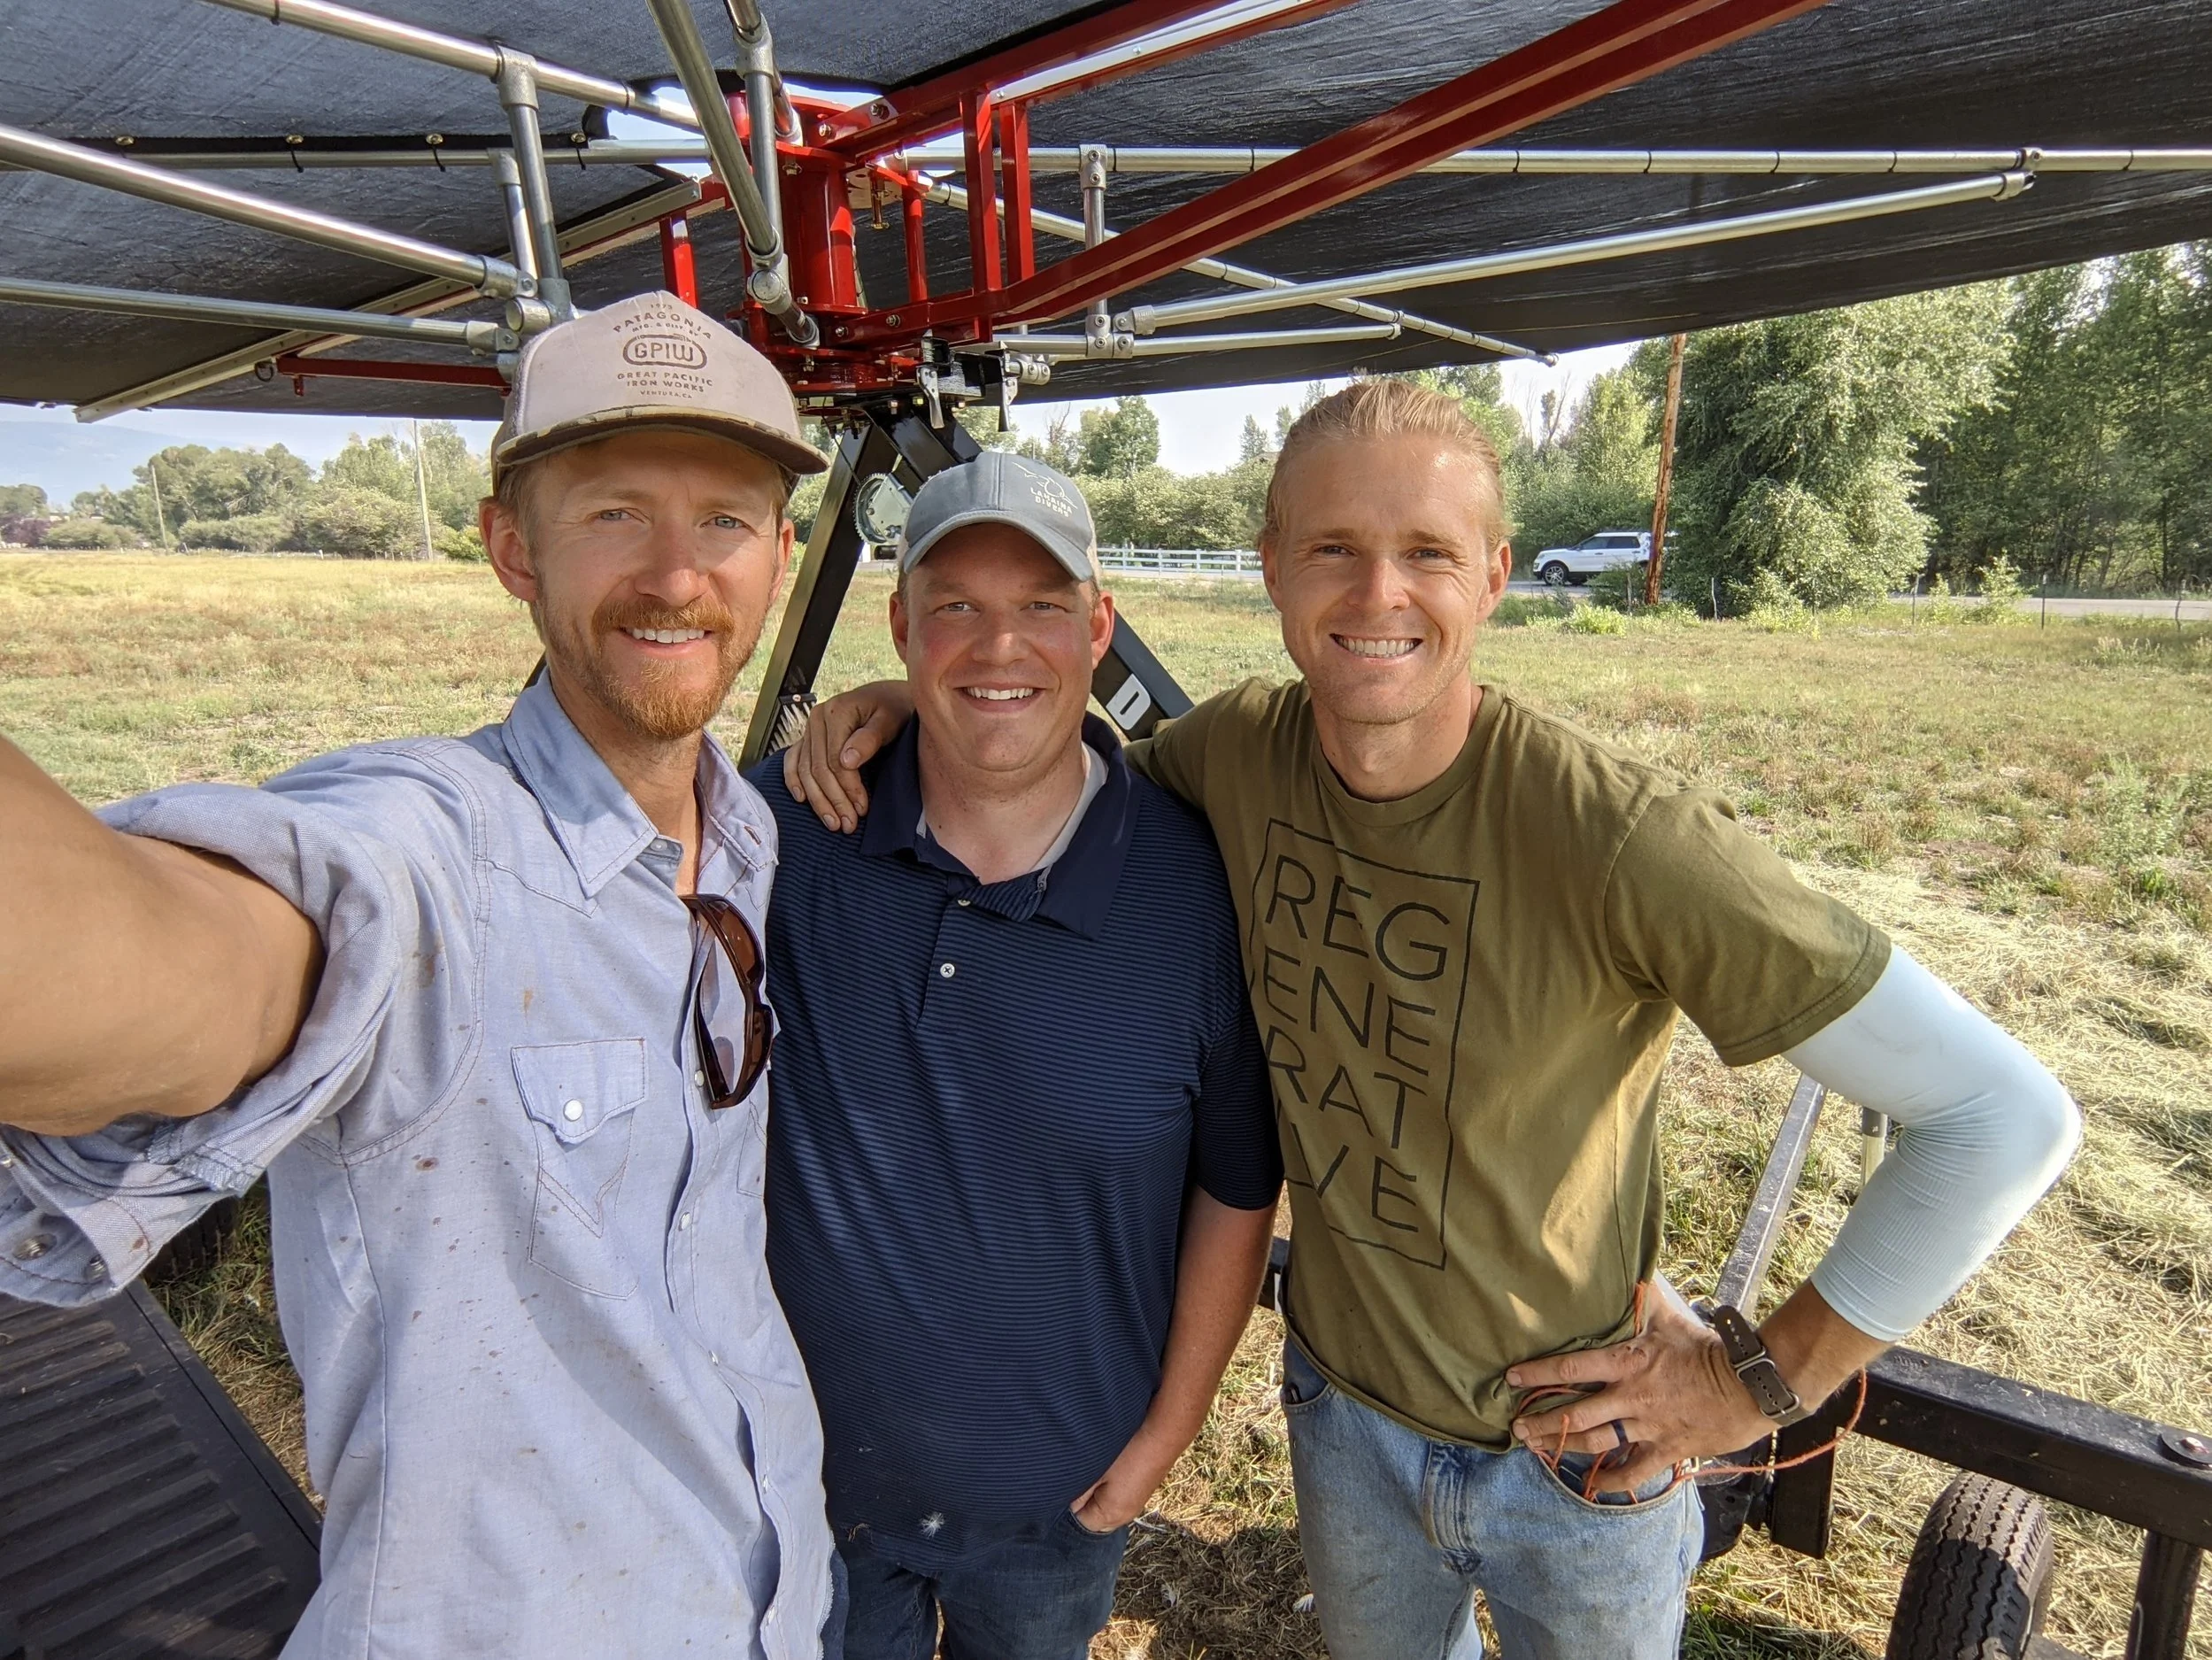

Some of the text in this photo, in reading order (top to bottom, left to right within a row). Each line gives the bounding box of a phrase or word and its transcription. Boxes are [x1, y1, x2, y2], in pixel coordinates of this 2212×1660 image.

[613, 312, 712, 339] PATAGONIA
[635, 343, 694, 362] GPIW
[663, 381, 705, 392] WORKS
[664, 373, 713, 387] PACIFIC
[1035, 495, 1069, 518] DIVERS
[1265, 854, 1450, 982] REG
[1264, 946, 1436, 1077] ENE
[1266, 1024, 1428, 1149] RAT
